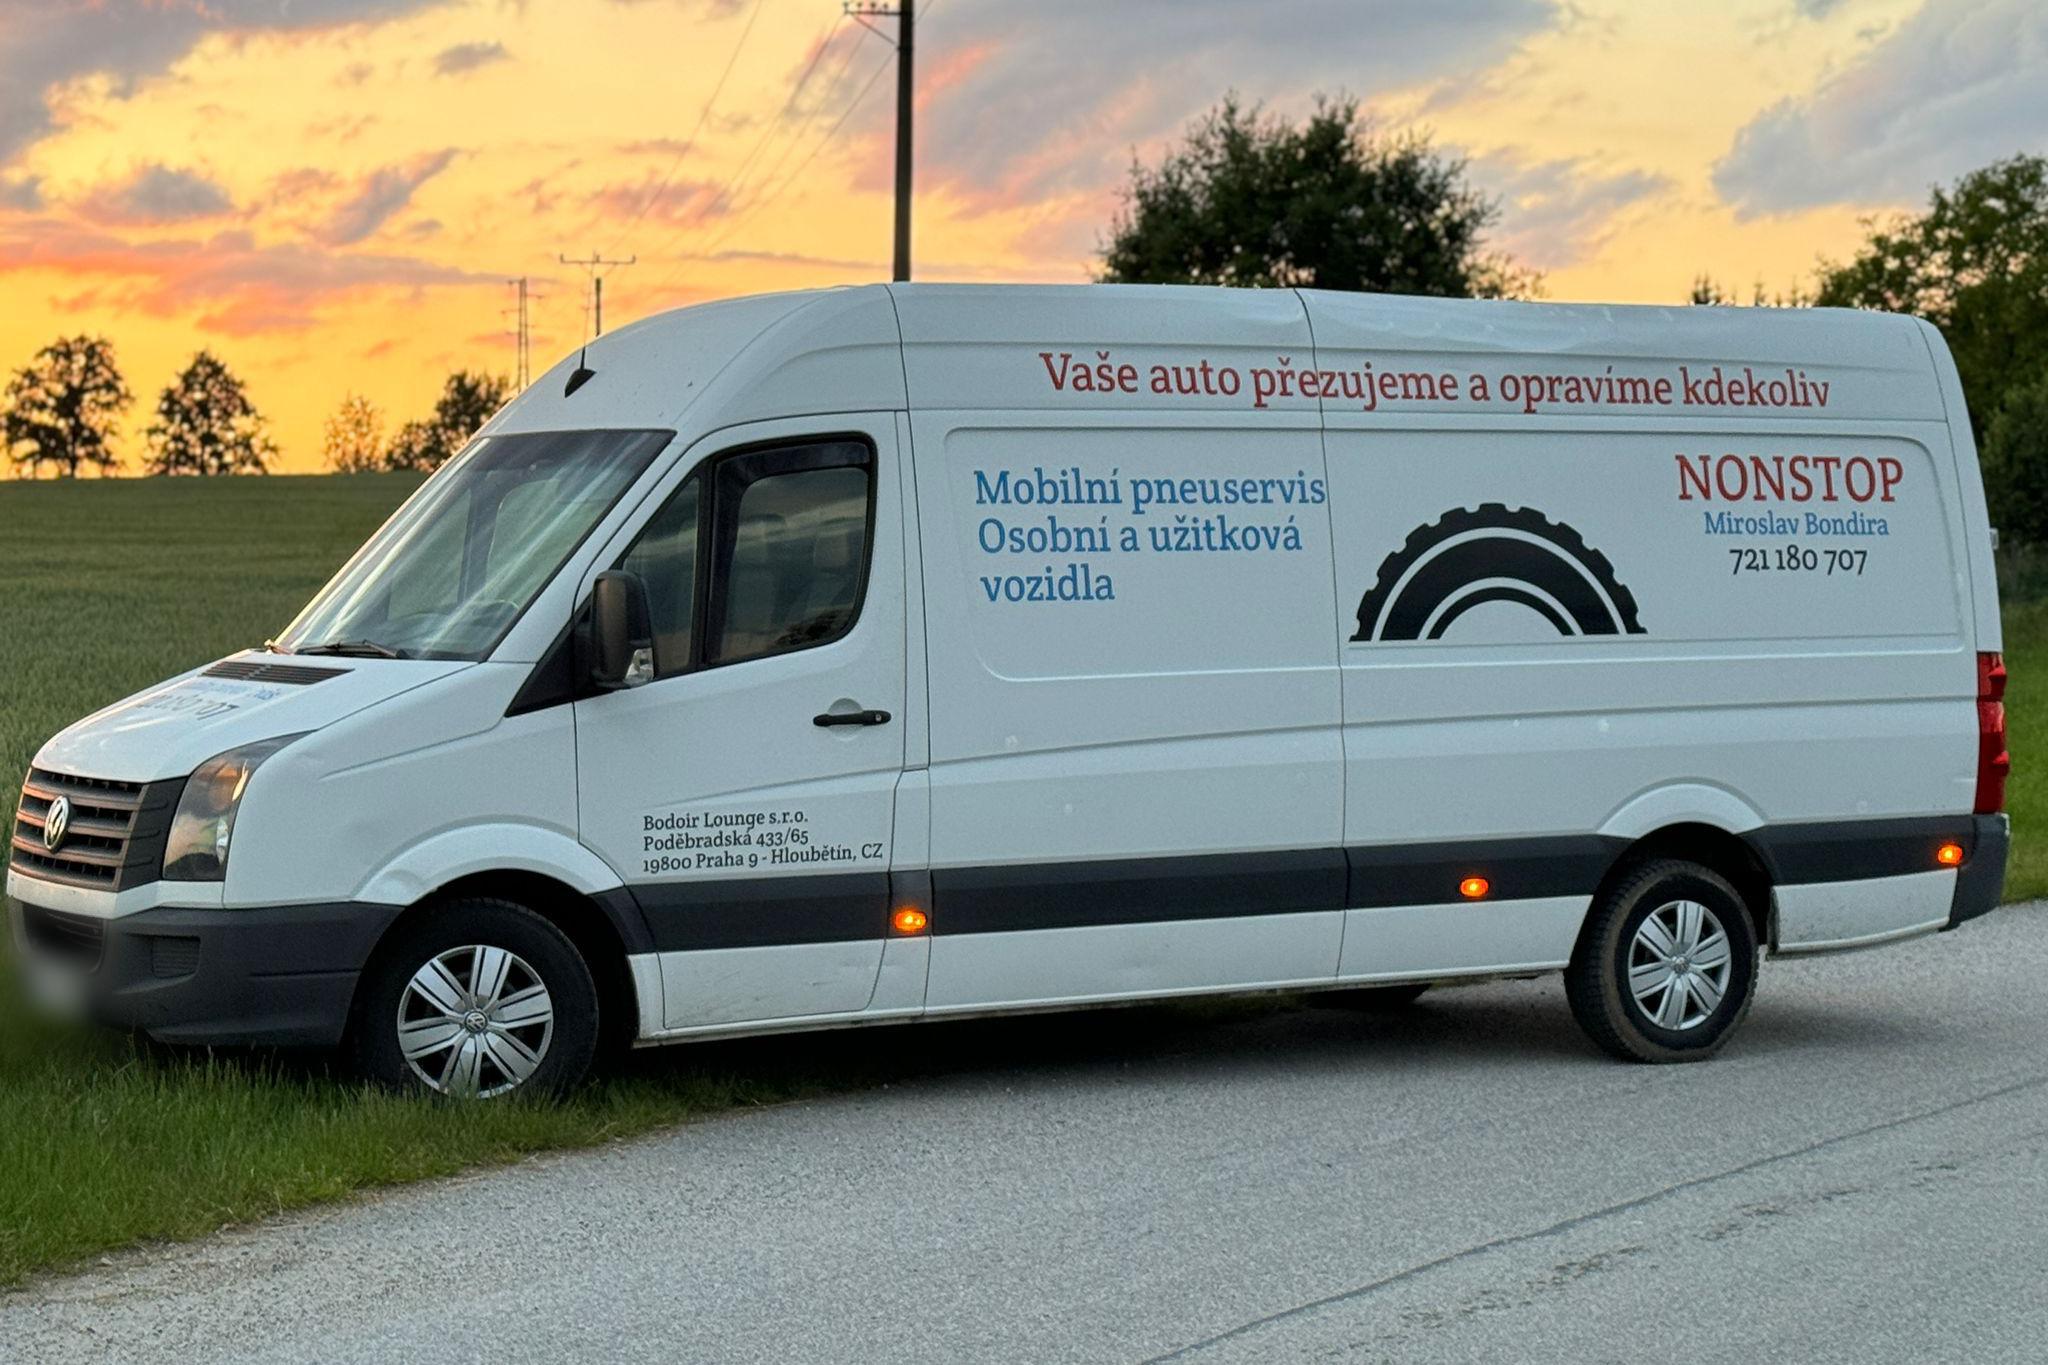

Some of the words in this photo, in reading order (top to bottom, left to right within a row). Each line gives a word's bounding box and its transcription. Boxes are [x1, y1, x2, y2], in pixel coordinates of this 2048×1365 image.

[1039, 351, 1138, 393] Vaše
[1150, 360, 1241, 395] auto
[1250, 356, 1459, 411] přezujeme
[1470, 375, 1490, 401] a
[1500, 366, 1672, 413] opravíme
[1680, 367, 1830, 408] kdekoliv
[974, 467, 1123, 506] Mobilní
[1130, 469, 1327, 515] pneuservis
[1675, 454, 1904, 502] NONSTOP
[978, 516, 1112, 553] Osobní
[1119, 525, 1140, 552] a
[1148, 515, 1303, 552] užitková
[1704, 510, 1799, 536] Miroslav
[1804, 511, 1889, 536] Bondira
[1729, 549, 1770, 576] 721
[1775, 544, 1818, 571] 180
[1823, 549, 1868, 576] 707
[979, 563, 1116, 602] vozidla
[643, 812, 700, 831] Bodoir
[703, 812, 765, 834] Lounge
[768, 811, 809, 825] s.r.o.
[643, 827, 752, 851] Poděbradská
[756, 827, 809, 847] 433/65
[643, 856, 692, 874] 19800
[695, 852, 744, 869] Praha
[748, 853, 759, 869] 9
[770, 843, 857, 865] Hloubětín,
[861, 842, 883, 859] CZ
